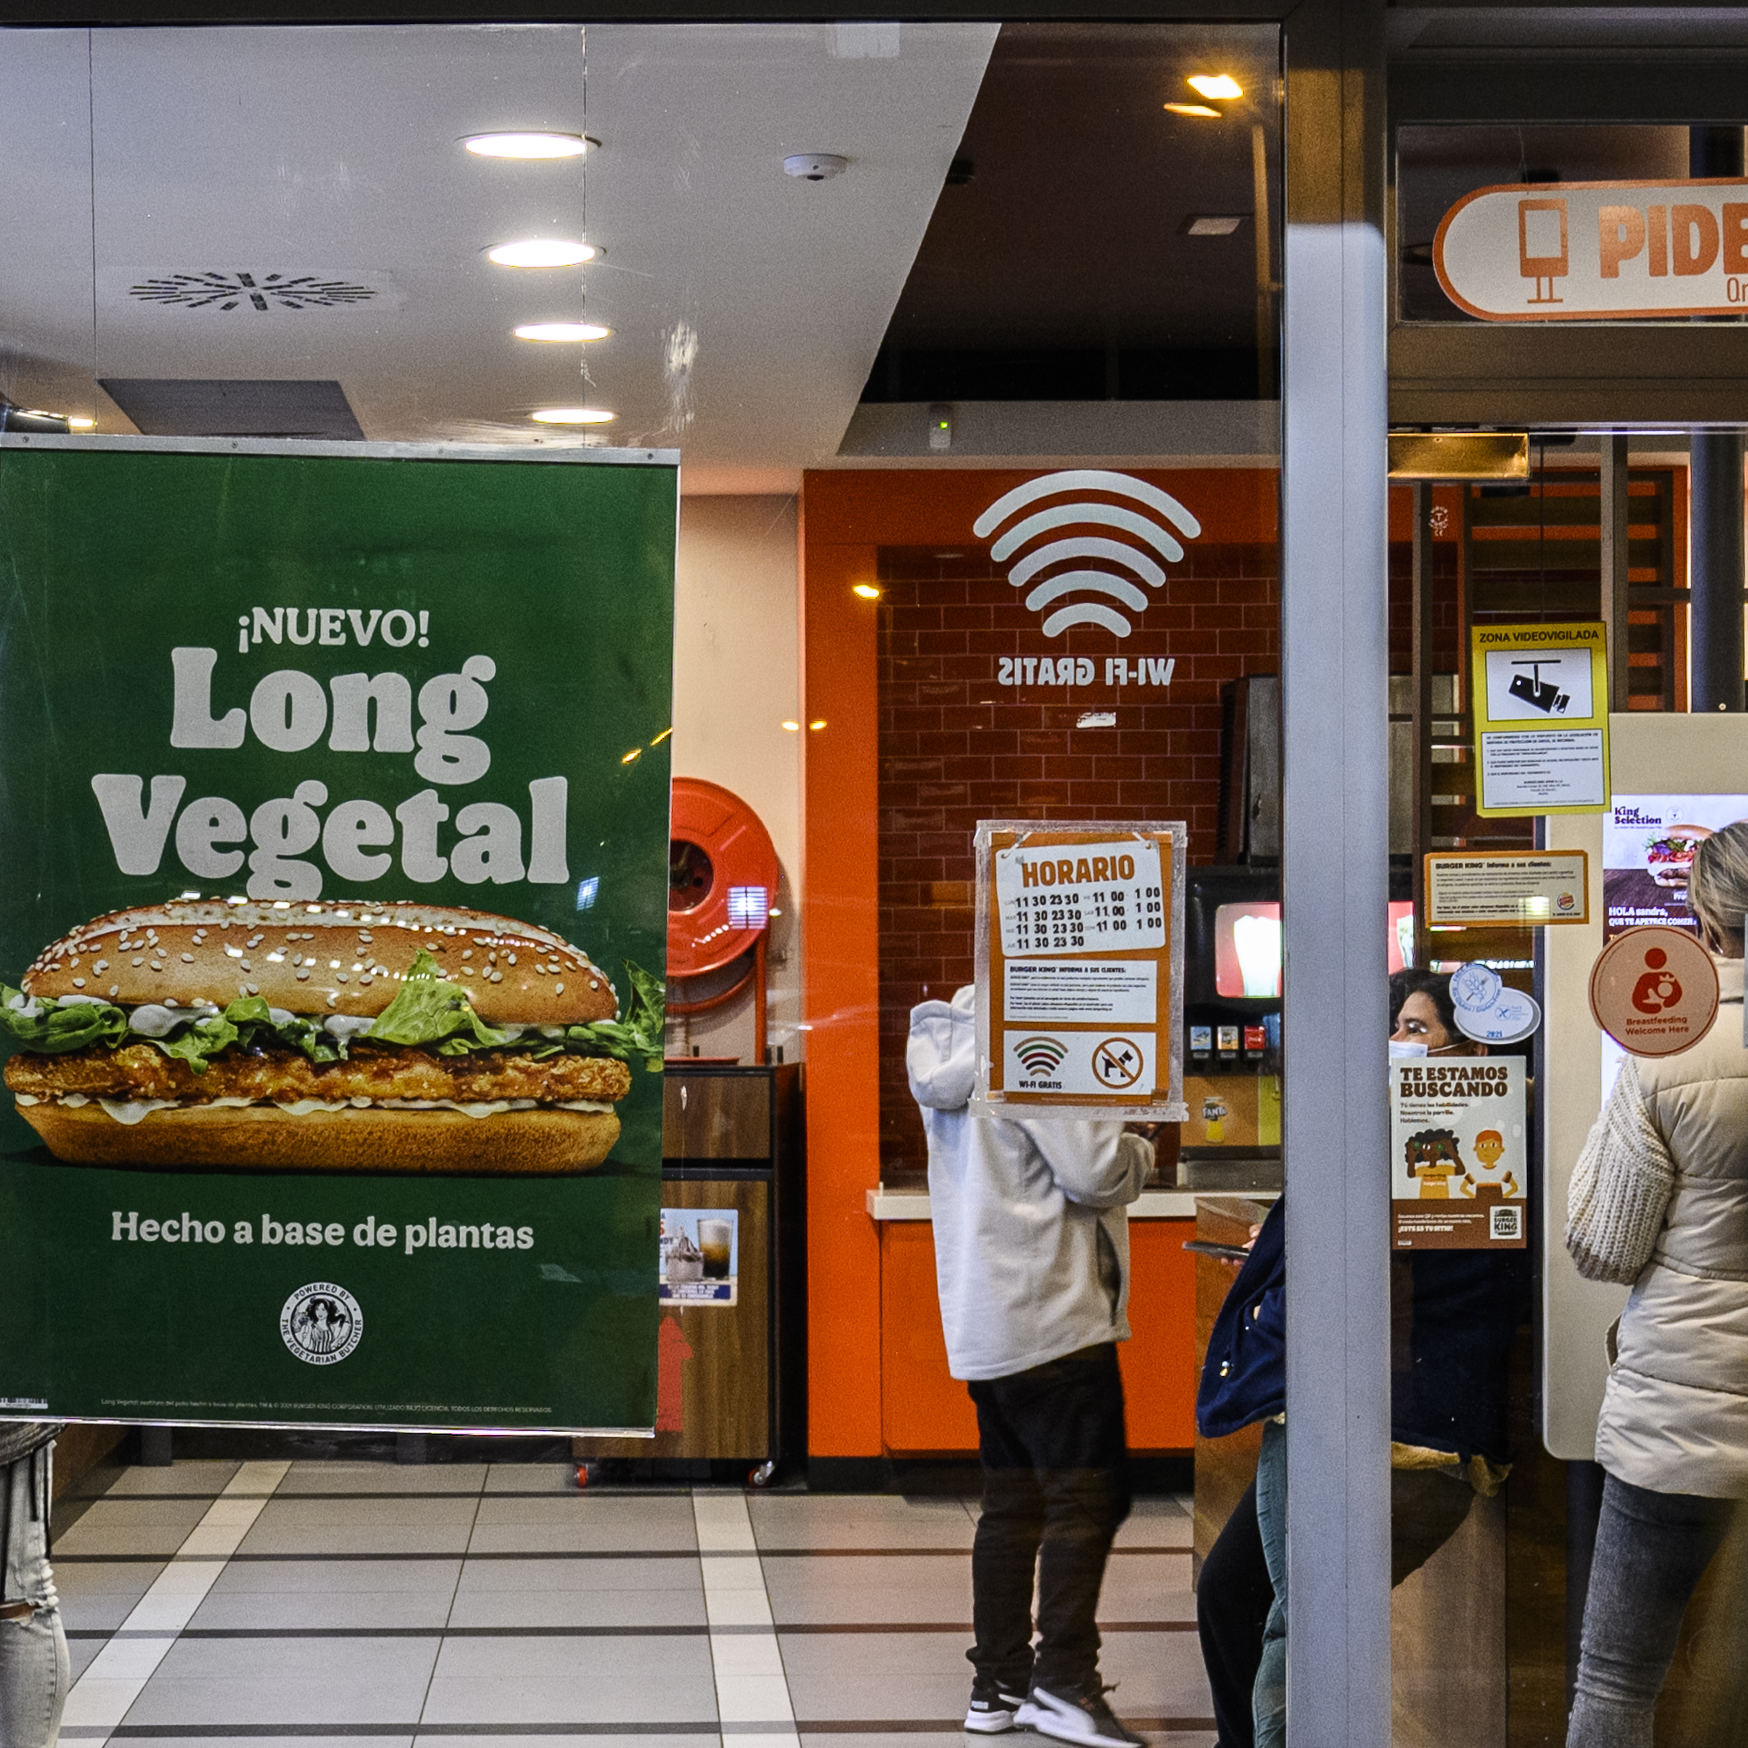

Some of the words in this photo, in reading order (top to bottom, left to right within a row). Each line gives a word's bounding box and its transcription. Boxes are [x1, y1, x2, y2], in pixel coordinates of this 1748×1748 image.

[238, 606, 430, 653] ¡NUEVO!
[1479, 633, 1511, 643] ZONA
[1513, 630, 1600, 642] VIDEOVIGILADA
[169, 645, 497, 785] Long
[1614, 806, 1640, 818] King
[1614, 815, 1662, 825] Selection
[90, 774, 570, 902] Vegetal
[1022, 854, 1135, 888] HORARIO
[1015, 896, 1029, 908] 11
[1032, 895, 1047, 907] 30
[1050, 894, 1063, 905] 23
[1065, 893, 1079, 905] 30
[1093, 892, 1105, 902] 11
[1110, 891, 1124, 902] 00
[1135, 888, 1141, 899] 1
[1146, 887, 1160, 898] 00
[1016, 911, 1028, 922] 11
[1034, 910, 1047, 922] 30
[1051, 909, 1065, 921] 23
[1067, 909, 1082, 921] 30
[1095, 906, 1108, 917] 11
[1112, 905, 1125, 916] 00
[1135, 902, 1142, 913] 1
[1146, 901, 1161, 912] 00
[1608, 906, 1635, 917] HOLA
[1635, 907, 1668, 918] sandra,
[1016, 924, 1028, 935] 11
[1034, 923, 1047, 934] 30
[1053, 922, 1067, 934] 23
[1069, 922, 1083, 933] 30
[1096, 921, 1108, 932] 11
[1113, 920, 1127, 931] 00
[1136, 919, 1142, 930] 1
[1147, 917, 1162, 928] 00
[1608, 918, 1624, 926] QUE
[1624, 918, 1634, 926] TE
[1634, 918, 1667, 926] APETECE
[1017, 939, 1029, 949] 11
[1035, 937, 1049, 948] 30
[1053, 936, 1067, 948] 23
[1070, 935, 1084, 947] 30
[1626, 1015, 1688, 1026] Breastfeeding
[1486, 1030, 1503, 1038] 2021
[1625, 1026, 1666, 1035] Welcome
[1668, 1025, 1689, 1034] Here
[1400, 1067, 1423, 1081] TE
[1426, 1066, 1508, 1081] ESTAMOS
[1019, 1079, 1037, 1089] WI-FI
[1038, 1080, 1062, 1090] GRATIS
[1400, 1082, 1508, 1097] BUSCANDO
[111, 1211, 226, 1243] Hecho
[233, 1219, 253, 1244] a
[260, 1213, 345, 1247] base
[353, 1215, 397, 1248] de
[404, 1216, 535, 1255] plantas
[1494, 1223, 1517, 1231] KING
[294, 1284, 338, 1300] POWERED
[339, 1290, 351, 1300] BY
[282, 1319, 290, 1336] THE
[286, 1338, 337, 1364] VEGETARIAN
[338, 1319, 362, 1358] BUTCHER
